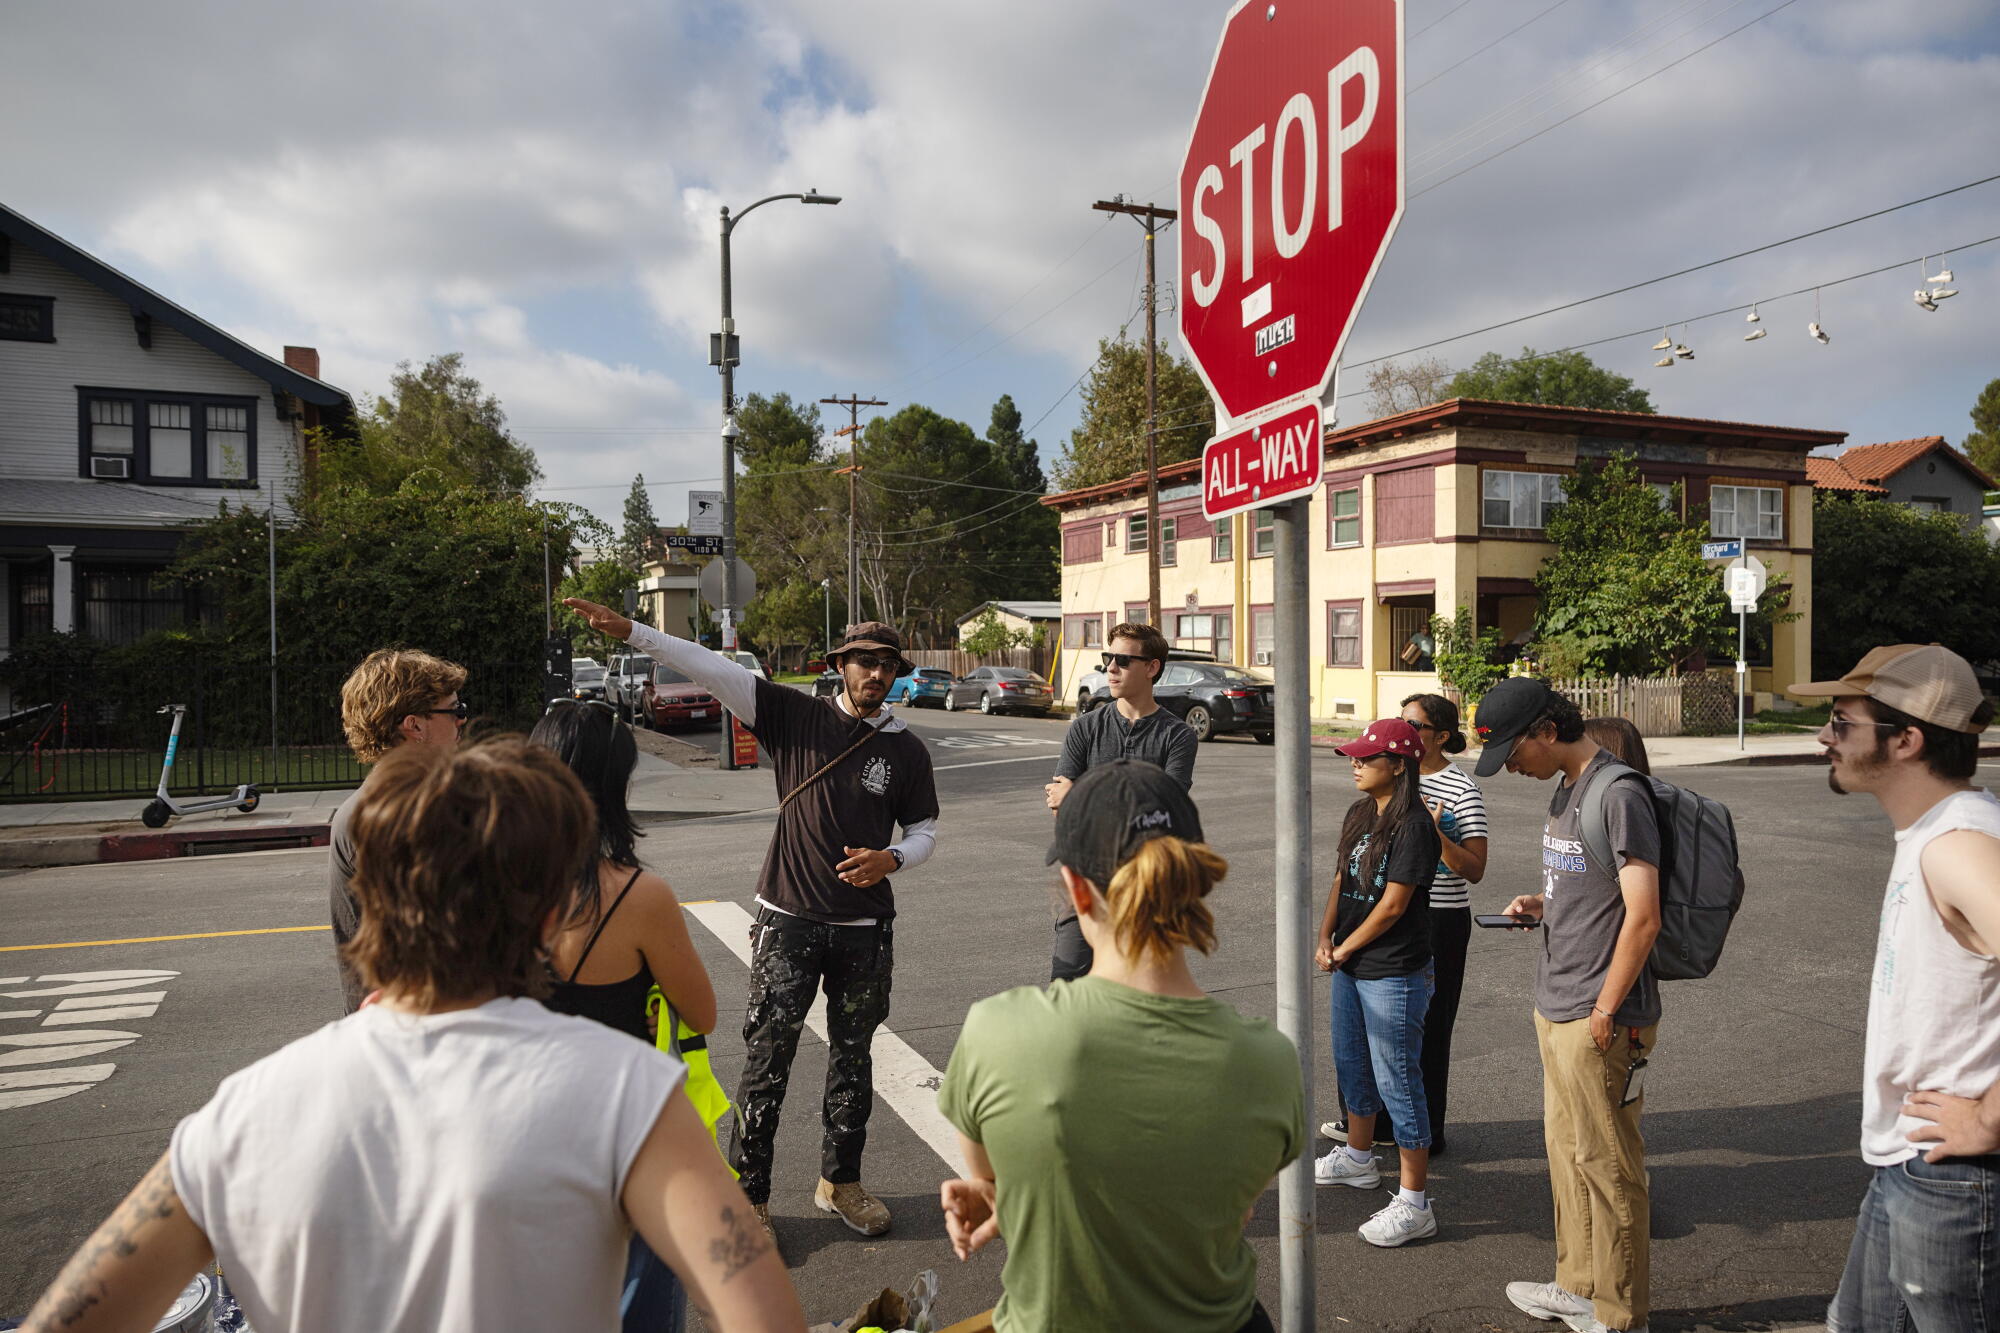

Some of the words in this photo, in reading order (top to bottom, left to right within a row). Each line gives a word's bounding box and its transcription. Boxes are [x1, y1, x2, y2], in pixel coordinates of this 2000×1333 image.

[1191, 46, 1380, 308] STOP
[1207, 418, 1315, 502] ALL-WAY
[669, 536, 697, 546] 30TH
[1703, 544, 1728, 553] Orchard
[862, 757, 876, 777] CINCO
